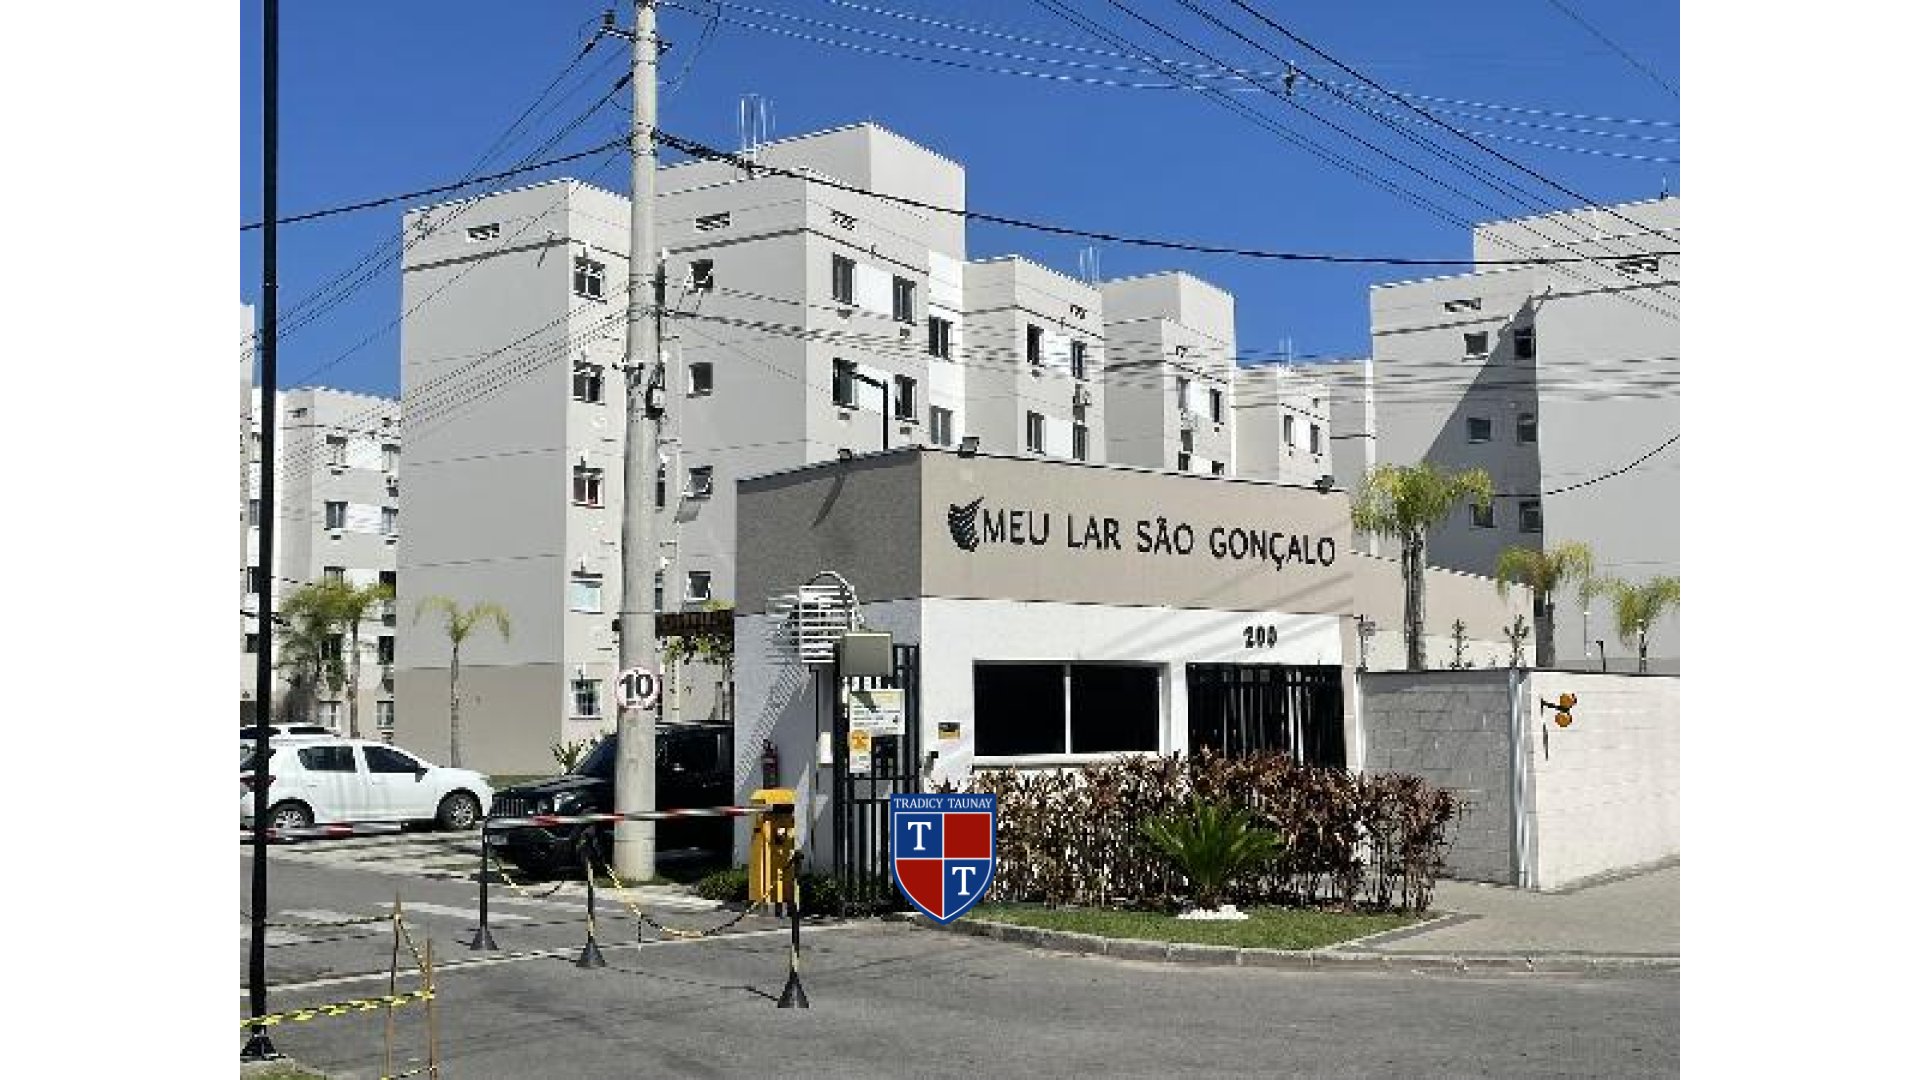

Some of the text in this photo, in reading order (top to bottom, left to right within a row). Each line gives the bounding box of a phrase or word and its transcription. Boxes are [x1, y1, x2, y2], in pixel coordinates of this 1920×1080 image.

[983, 508, 1335, 572] MEU LAR SÃO GONÇALO
[619, 673, 654, 699] 10
